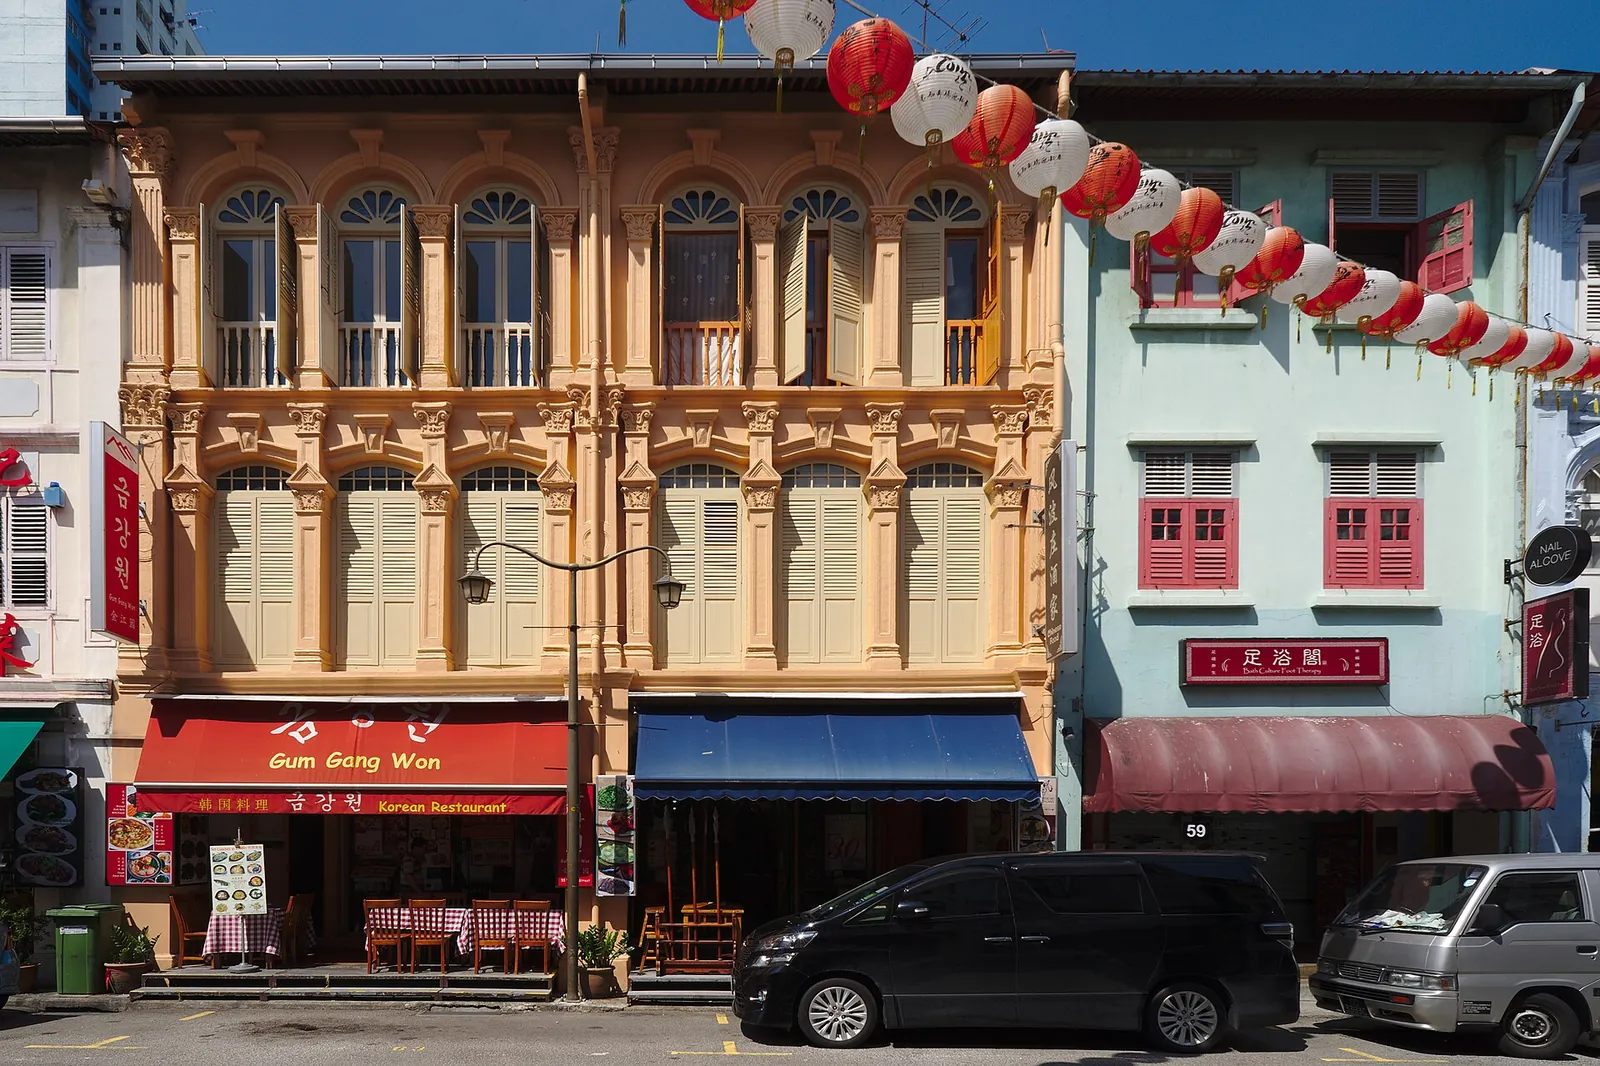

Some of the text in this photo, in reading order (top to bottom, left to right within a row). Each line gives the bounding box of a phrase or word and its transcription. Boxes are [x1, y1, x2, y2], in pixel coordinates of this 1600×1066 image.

[113, 476, 131, 590] 금강원
[1539, 541, 1563, 555] NAIL
[1529, 550, 1572, 570] ALCOVE
[1529, 613, 1544, 649] 足浴
[1242, 648, 1322, 666] 足浴閣
[1259, 667, 1281, 675] Culture
[1297, 667, 1322, 675] Therapy
[268, 751, 441, 774] Gum Gang Won
[199, 798, 269, 811] 韩国料理
[285, 792, 362, 812] 금강원
[378, 801, 507, 813] Korean Restaurant
[1186, 824, 1206, 838] 59
